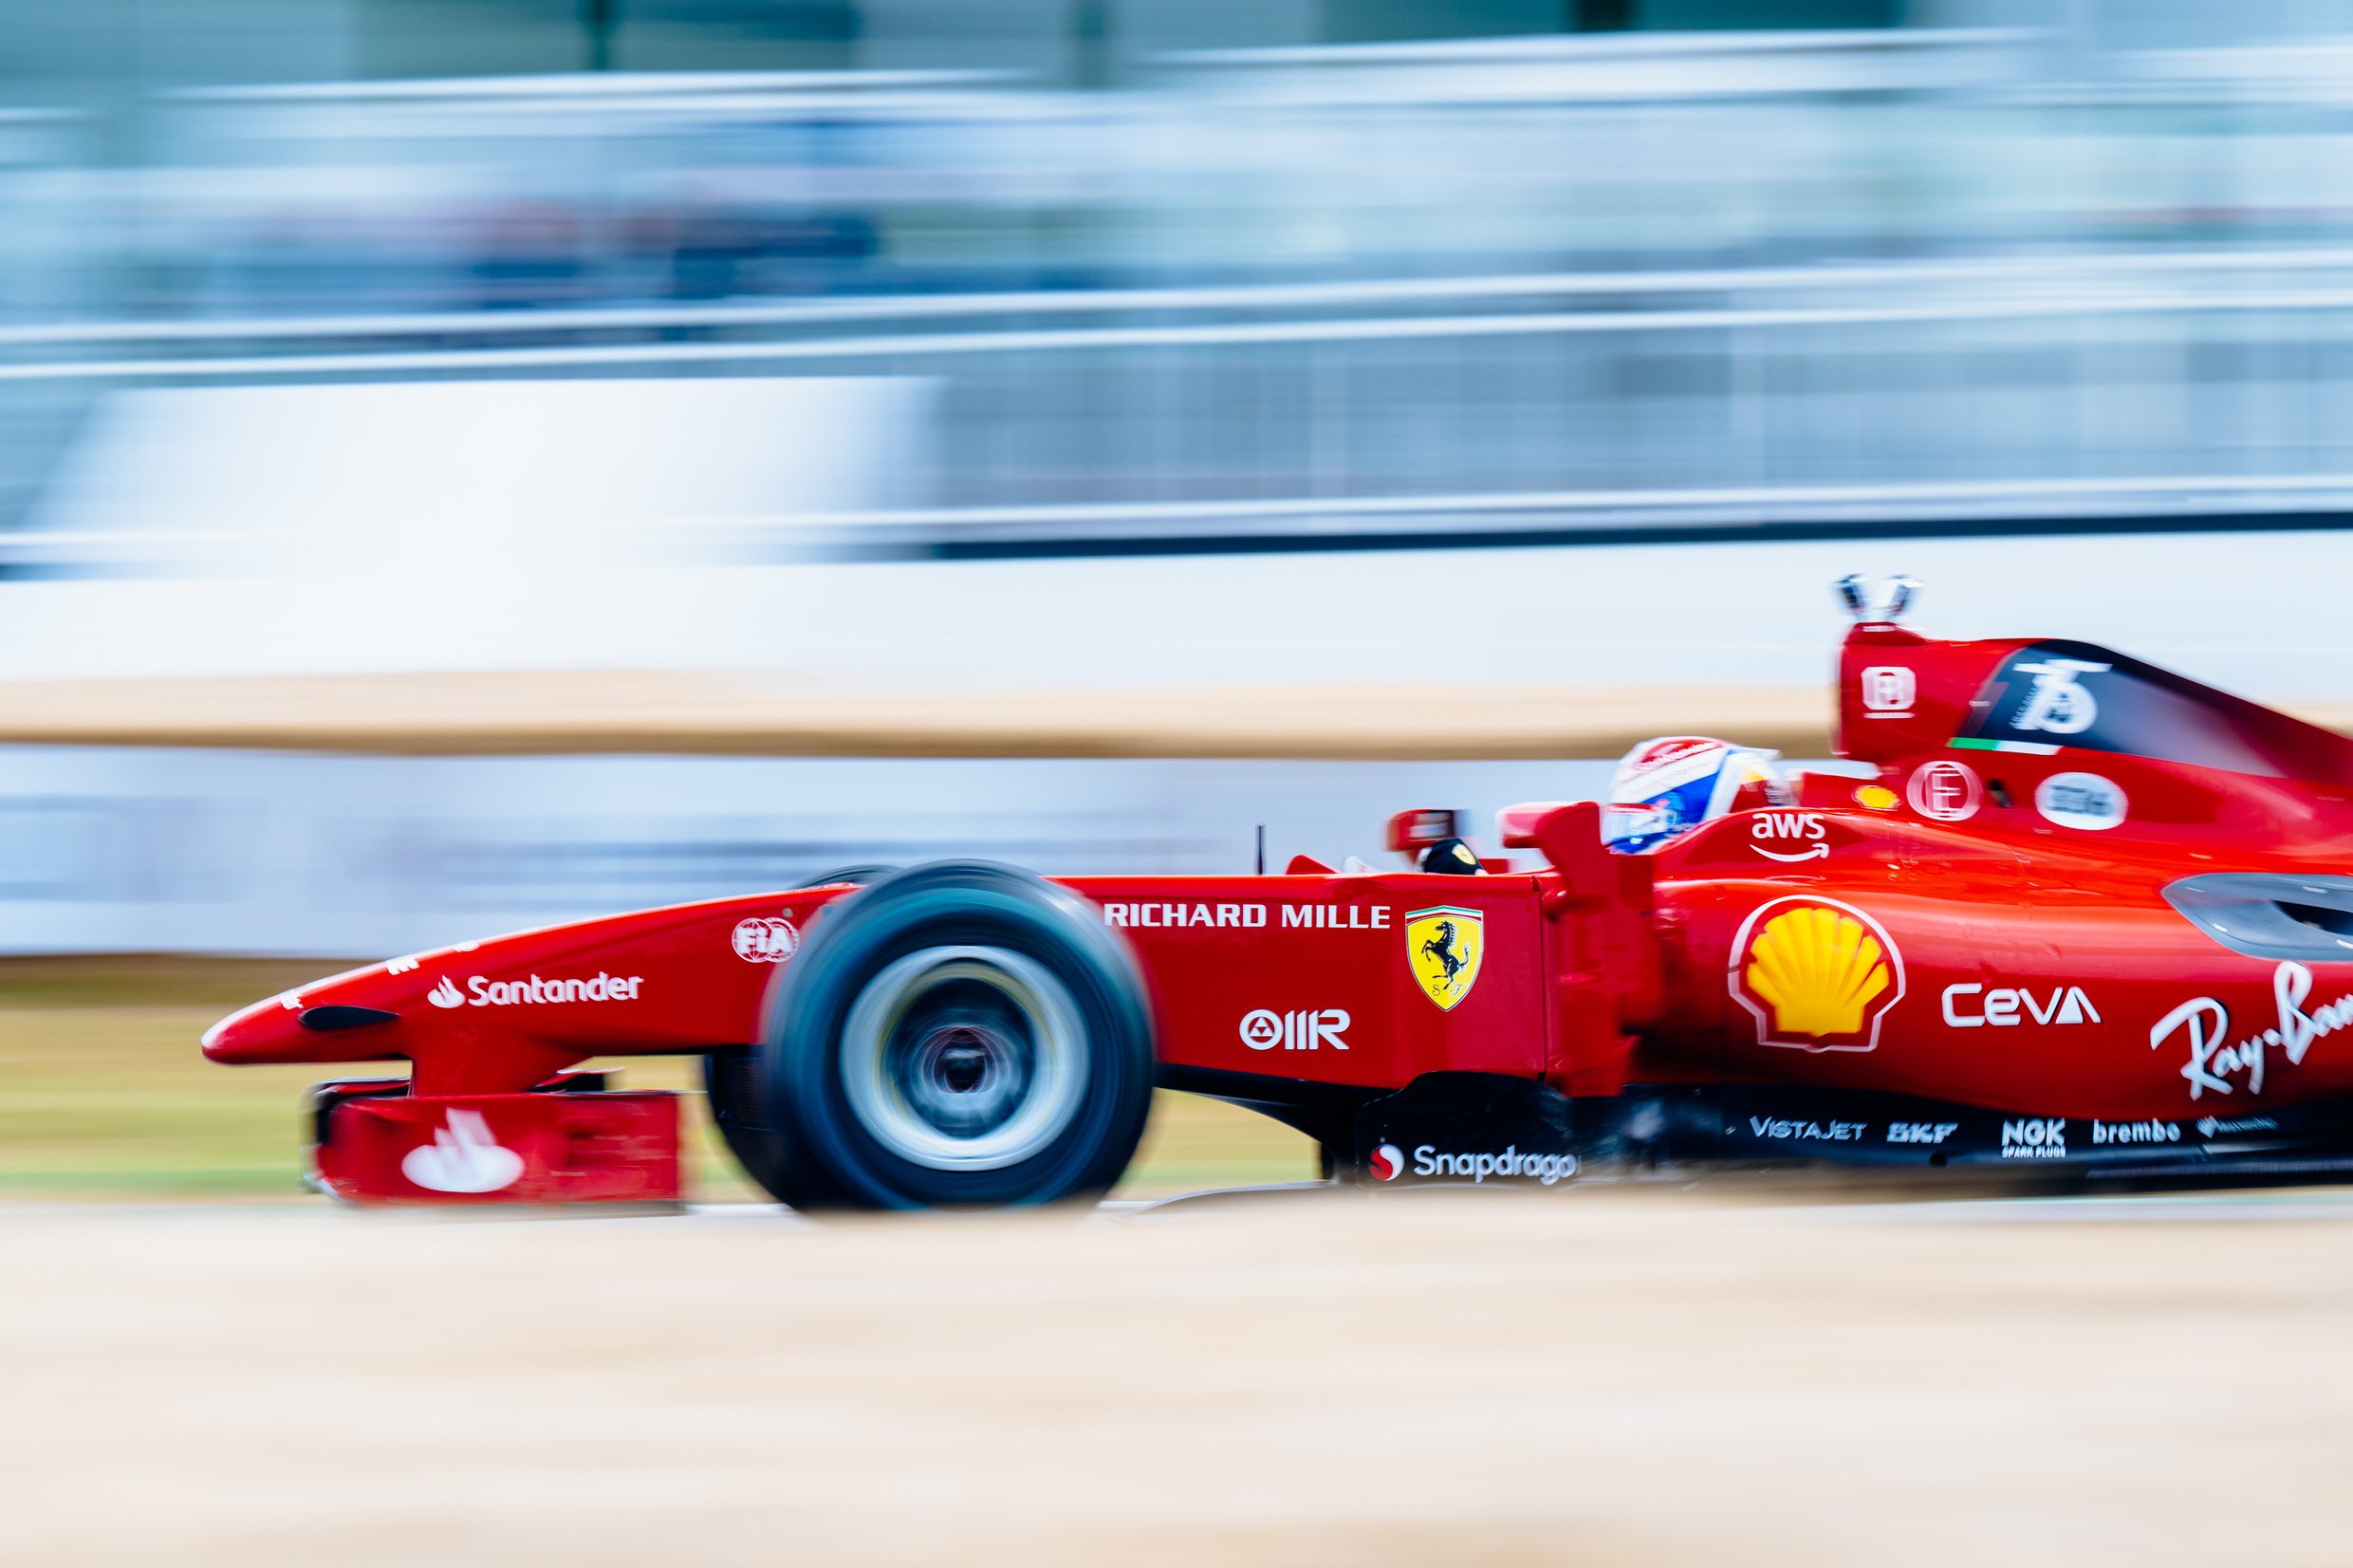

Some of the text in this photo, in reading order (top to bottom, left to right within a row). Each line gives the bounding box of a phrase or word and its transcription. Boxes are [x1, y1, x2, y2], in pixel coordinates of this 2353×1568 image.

[1751, 812, 1825, 840] aws
[1103, 903, 1392, 929] RICHARD MILLE
[468, 971, 644, 1006] Santander
[2001, 1117, 2066, 1146] NGK
[2092, 1117, 2181, 1144] brembo
[2002, 1145, 2066, 1158] SPARK PLUGS
